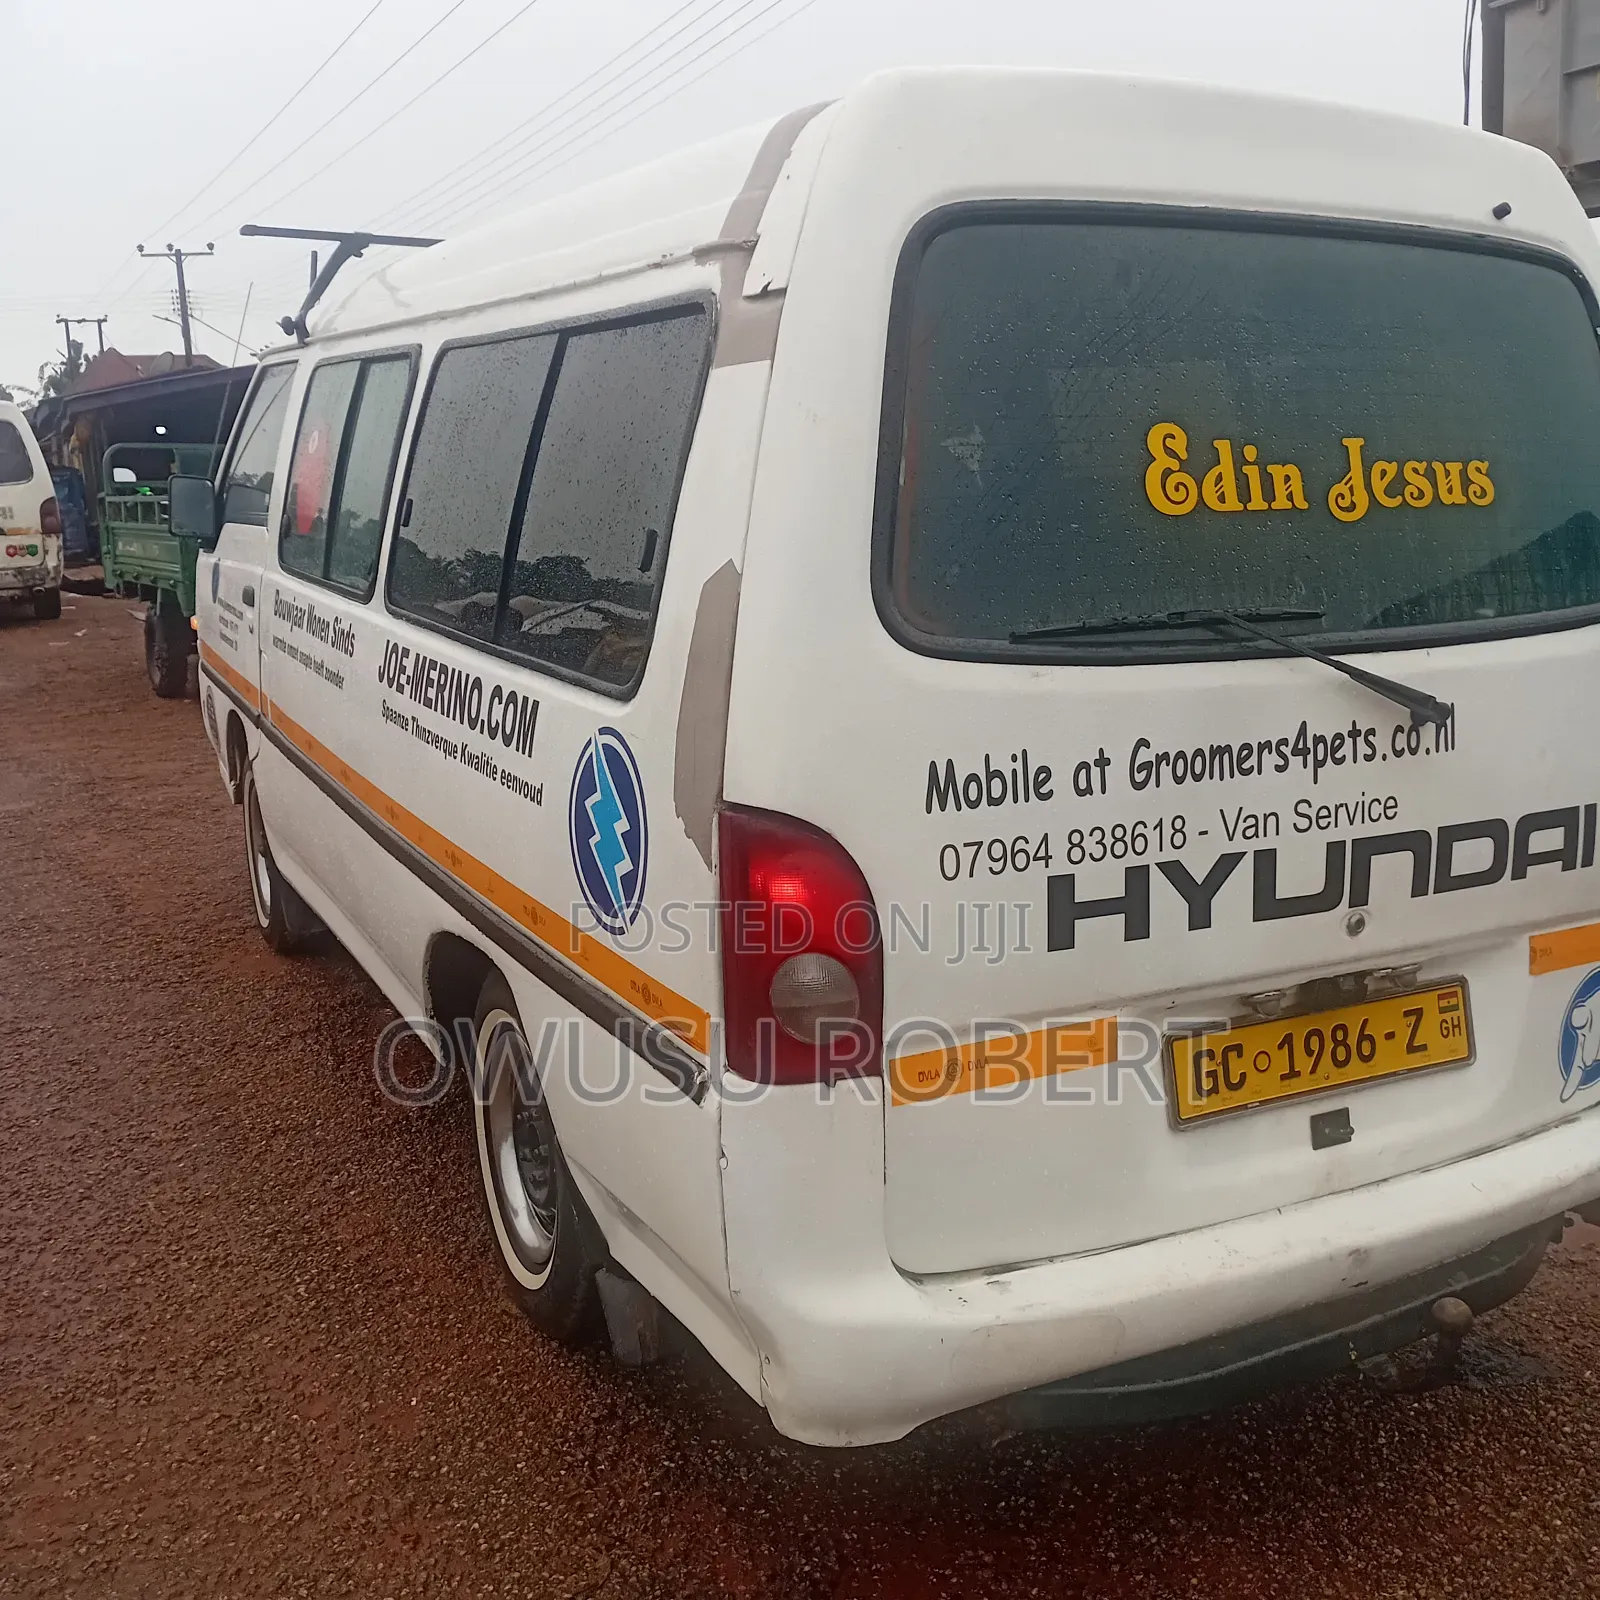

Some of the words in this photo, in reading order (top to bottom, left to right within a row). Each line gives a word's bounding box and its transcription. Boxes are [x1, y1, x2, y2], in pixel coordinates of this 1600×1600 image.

[1145, 422, 1309, 516] Edin
[1328, 437, 1495, 522] Jesus
[274, 589, 306, 632] Bouwjaar
[306, 603, 330, 644] Wonen
[331, 616, 355, 658] Sinds
[378, 639, 540, 758] JOE-MERINO.COM
[460, 742, 498, 782] Kwalitie
[500, 768, 544, 807] eenvoud
[925, 748, 1053, 814] Mobile
[1073, 747, 1111, 797] at
[939, 832, 1053, 881] 07964
[1066, 815, 1187, 865] 838618
[1219, 806, 1280, 842] Van
[1293, 791, 1398, 833] Service
[1047, 803, 1597, 952] HYUNDAI
[1439, 1016, 1462, 1039] GH
[918, 1069, 940, 1083] DVLA
[1192, 1042, 1247, 1098] GC
